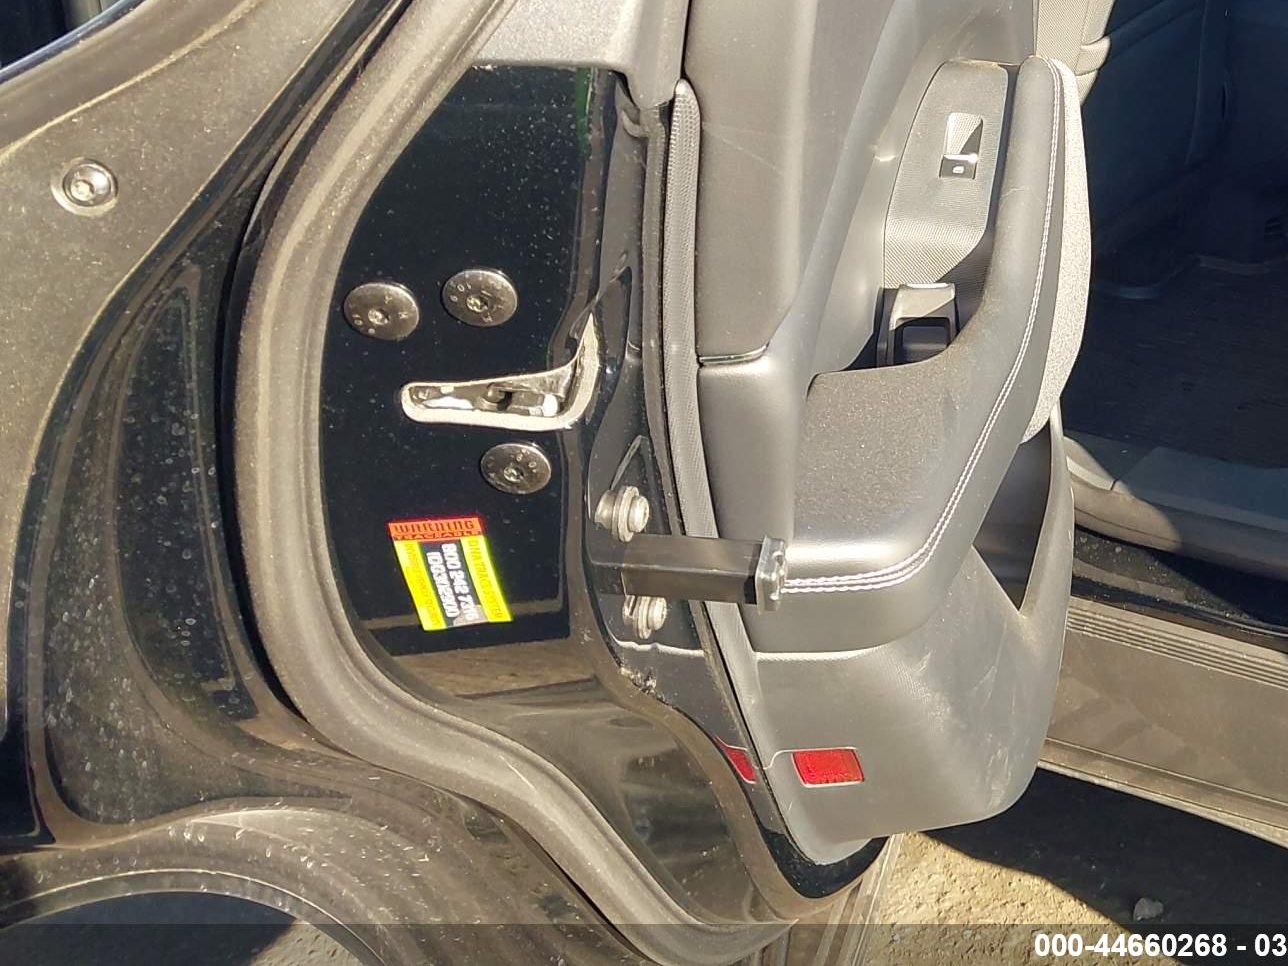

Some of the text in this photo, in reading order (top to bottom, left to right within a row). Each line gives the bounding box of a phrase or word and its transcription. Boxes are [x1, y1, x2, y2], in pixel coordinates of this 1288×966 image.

[393, 521, 475, 534] WARNING
[439, 543, 463, 569] 800
[448, 570, 470, 594] 242
